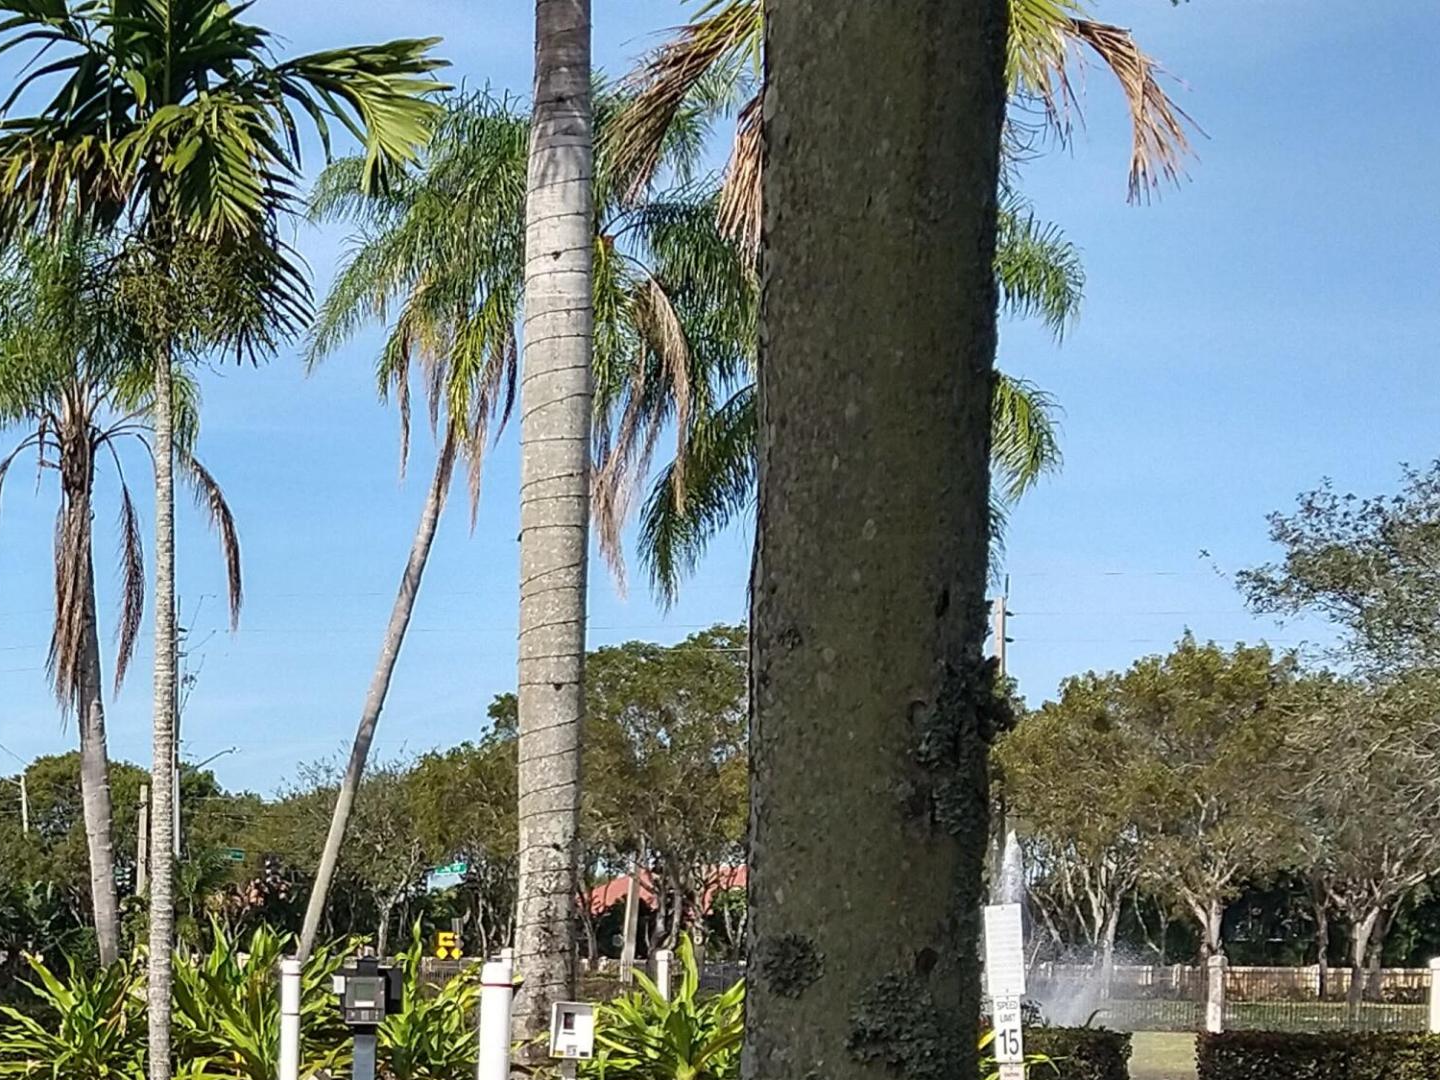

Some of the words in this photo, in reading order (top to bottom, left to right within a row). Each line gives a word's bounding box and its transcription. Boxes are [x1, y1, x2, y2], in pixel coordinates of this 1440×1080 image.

[996, 1000, 1018, 1010] SPEED
[1000, 1013, 1016, 1023] LIMIT
[999, 1029, 1019, 1055] 15
